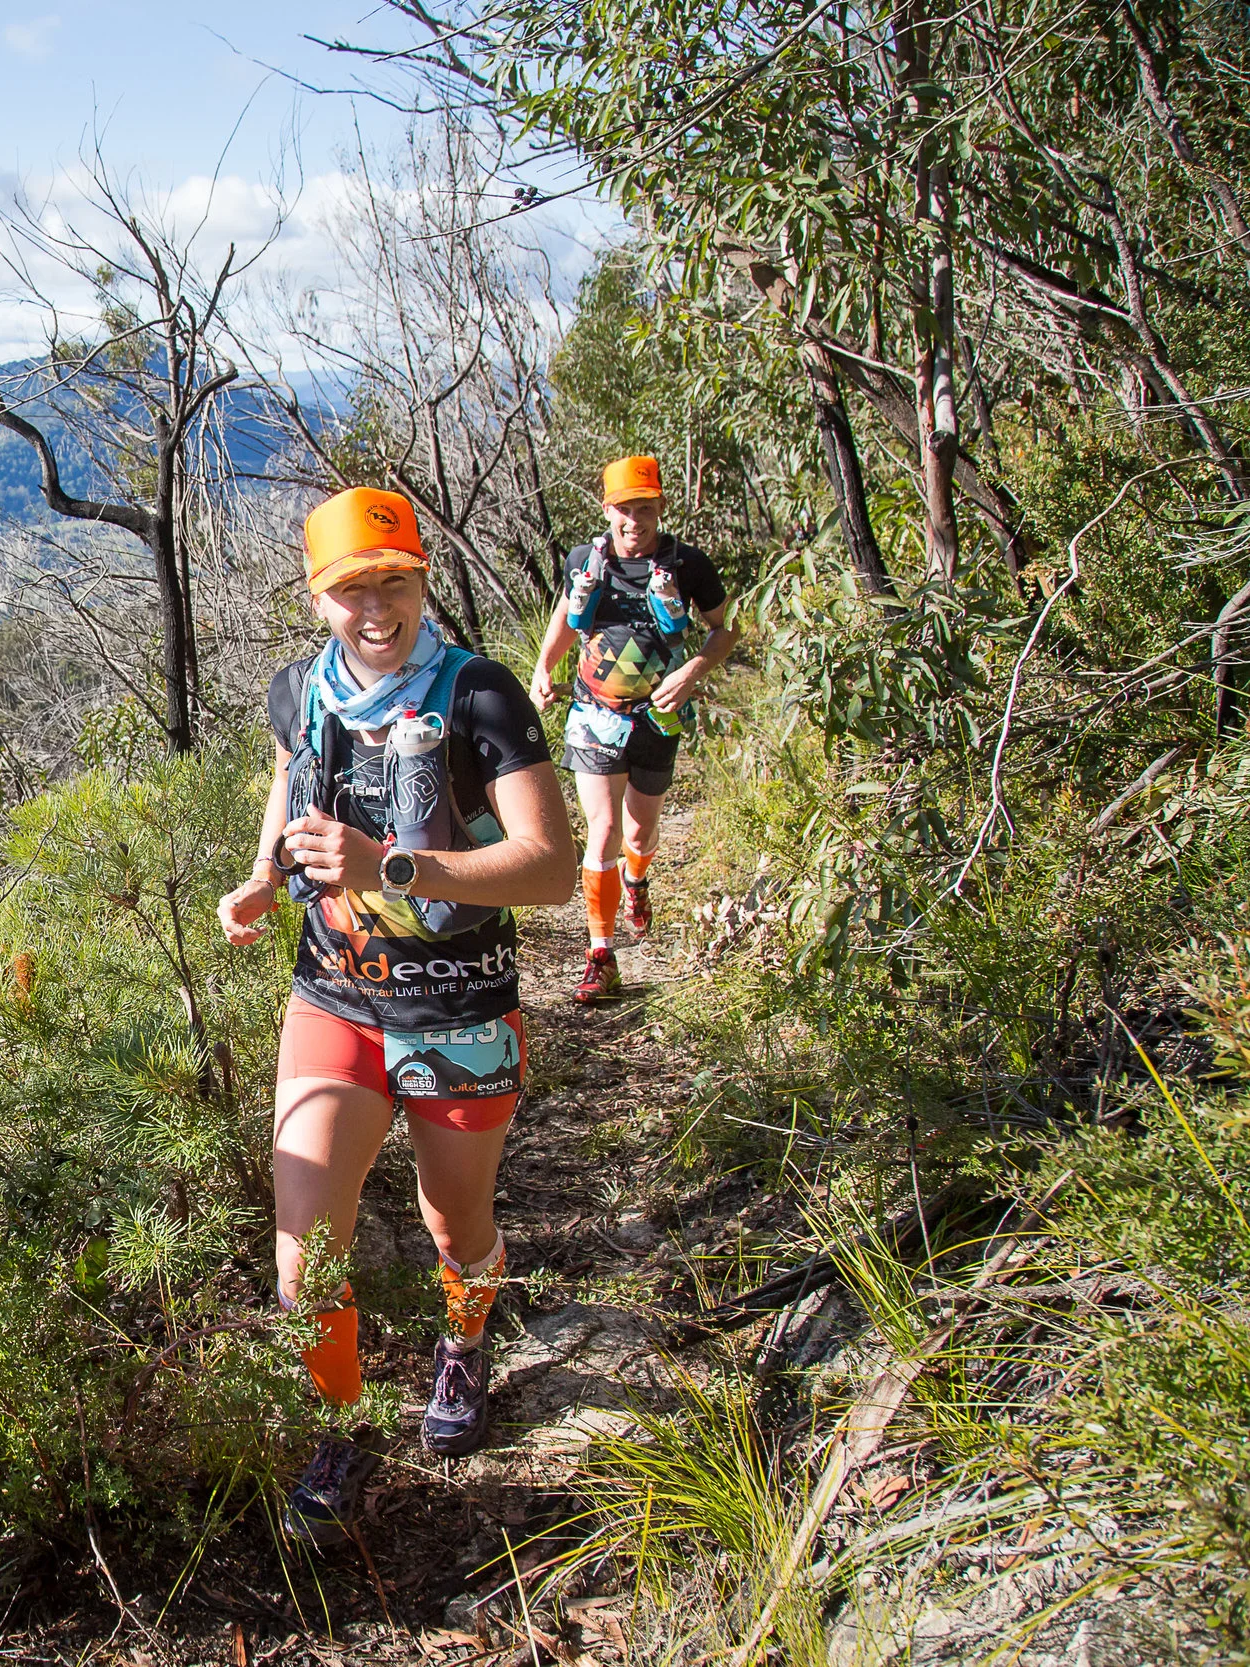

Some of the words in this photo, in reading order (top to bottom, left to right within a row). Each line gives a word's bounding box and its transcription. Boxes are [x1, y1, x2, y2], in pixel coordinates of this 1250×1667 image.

[395, 986, 423, 998] LIVE
[431, 982, 458, 995] LIFE
[419, 1080, 433, 1088] 50
[449, 1078, 513, 1093] wildearth
